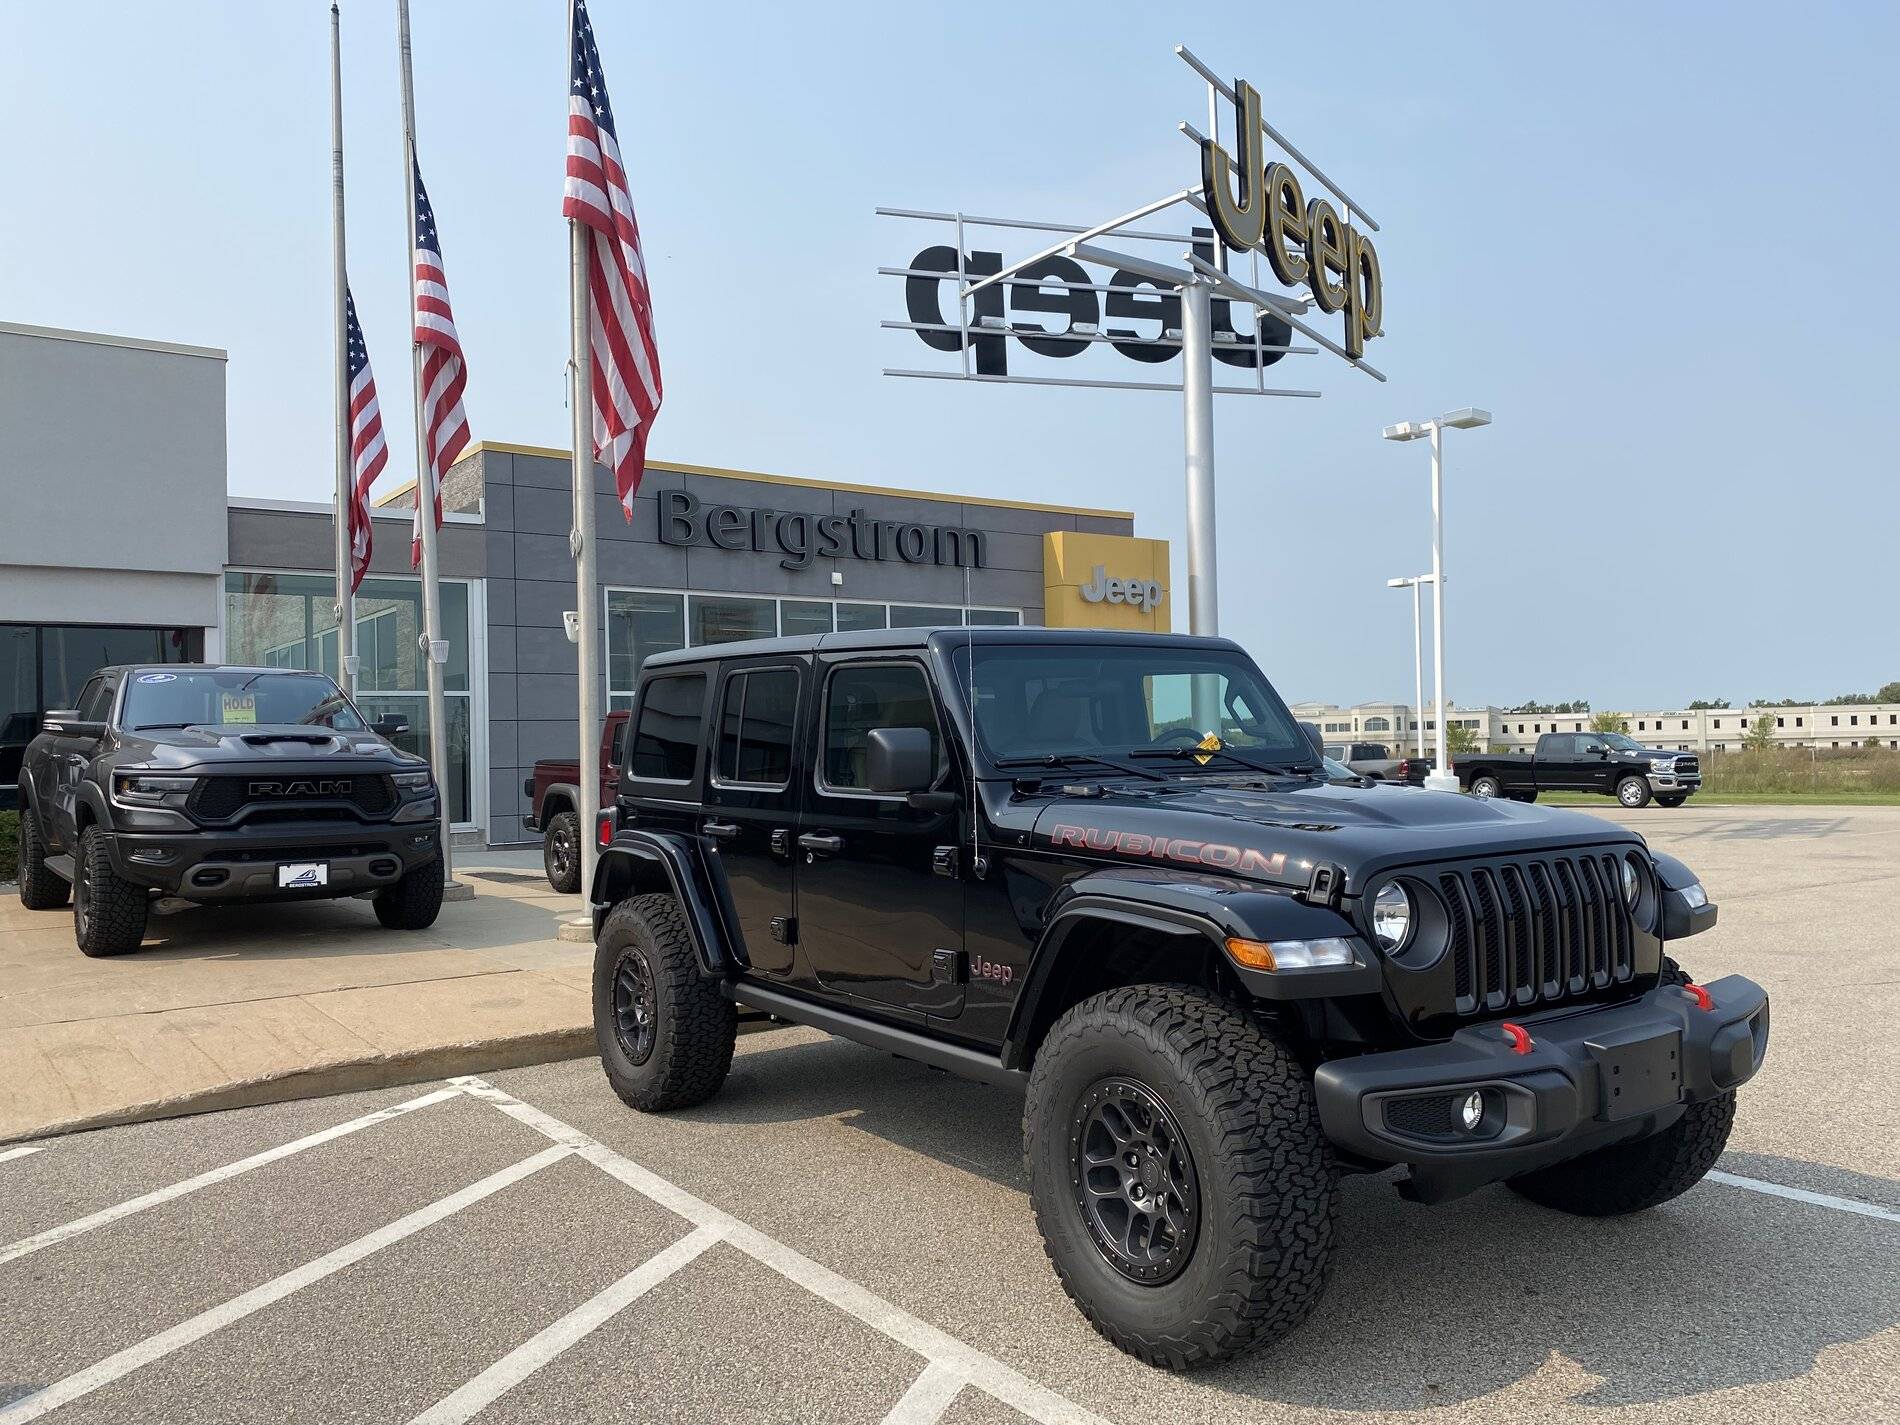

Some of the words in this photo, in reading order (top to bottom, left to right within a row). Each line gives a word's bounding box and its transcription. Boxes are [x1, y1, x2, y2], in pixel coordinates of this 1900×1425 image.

[1201, 78, 1383, 358] Jeep
[657, 489, 987, 571] Bergstrom
[1080, 564, 1163, 613] Jeep
[223, 698, 254, 710] HOLD
[248, 780, 352, 796] RAM
[1052, 824, 1287, 875] RUBICON
[971, 954, 1013, 986] Jeep
